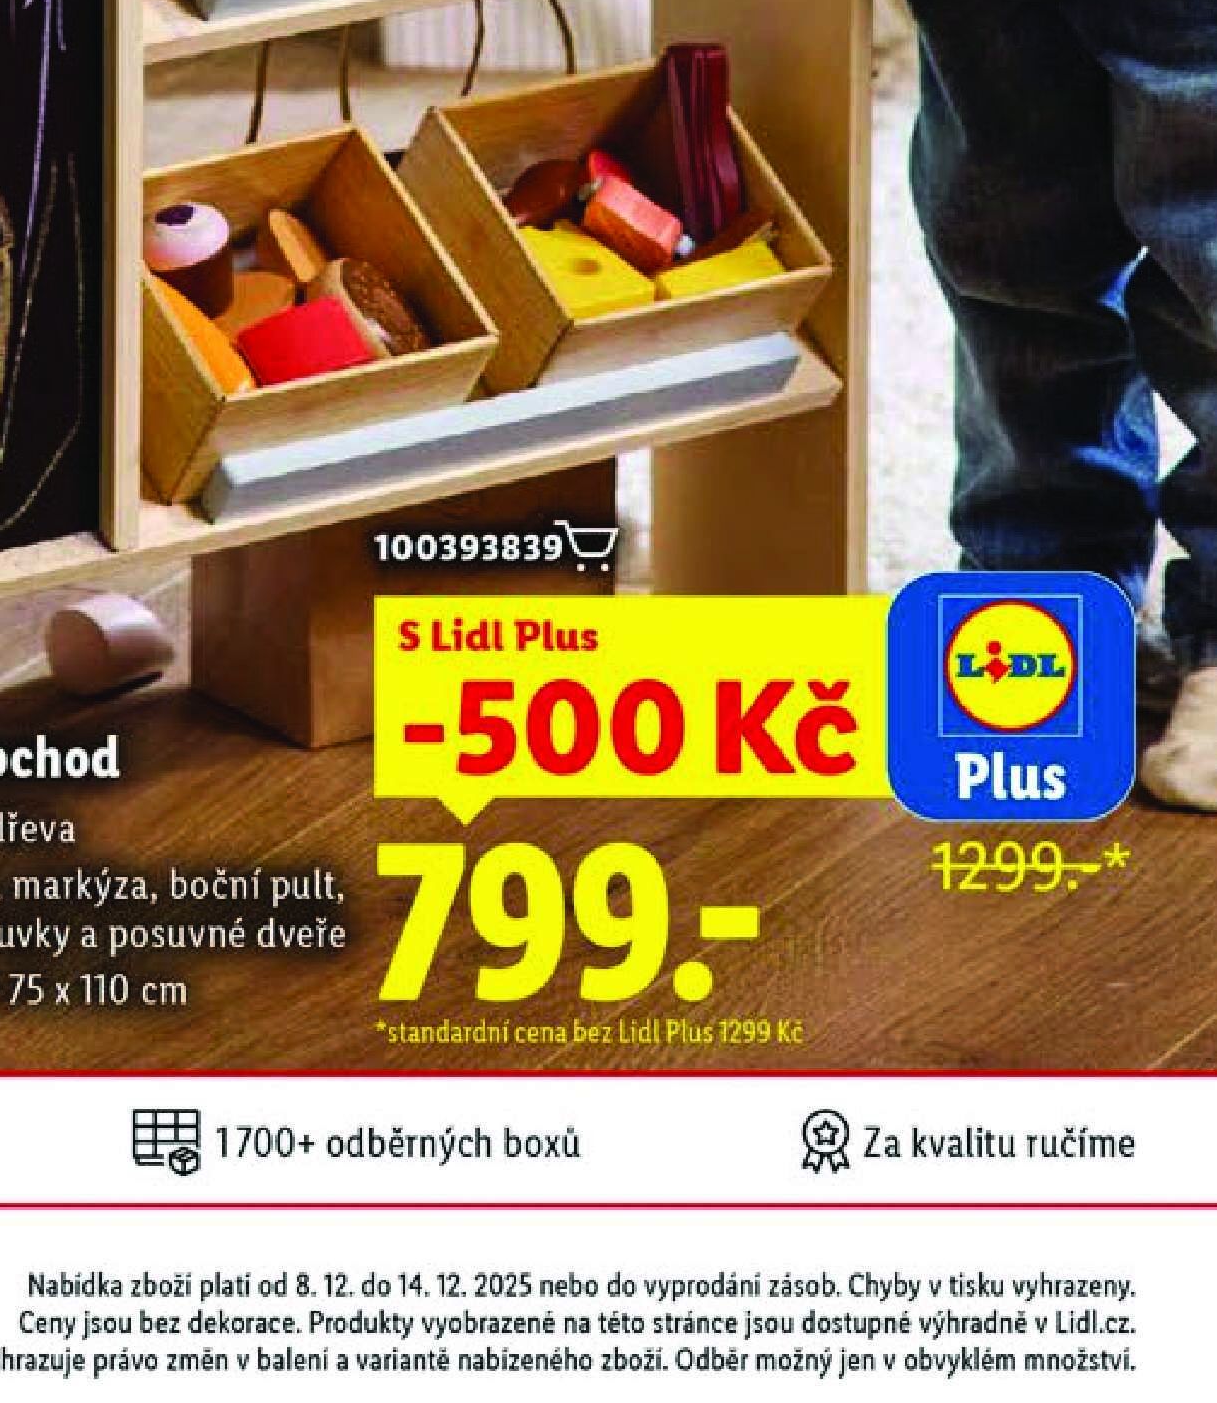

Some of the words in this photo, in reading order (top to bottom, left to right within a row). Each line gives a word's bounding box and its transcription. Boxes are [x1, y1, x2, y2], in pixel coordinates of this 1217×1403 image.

[373, 534, 563, 562] 100393839
[400, 621, 421, 652] S
[431, 618, 504, 652] Lidl
[513, 619, 599, 652] Plus
[956, 640, 1066, 683] LIDL
[404, 678, 686, 777] -500
[715, 680, 857, 777] Kč
[955, 751, 1065, 800] Plus
[13, 869, 158, 907] markýza,
[171, 869, 262, 900] boční
[272, 869, 344, 907] pult,
[81, 927, 98, 948] a
[110, 917, 245, 957] posuvné
[257, 917, 346, 948] dveře
[9, 973, 42, 1003] 75
[55, 982, 69, 1003] x
[81, 973, 129, 1003] 110
[142, 982, 187, 1003] cm
[513, 1026, 568, 1047] cena
[571, 1018, 614, 1046] bez
[619, 1017, 661, 1045] Lidl
[665, 1017, 715, 1045] Plus
[718, 1017, 773, 1044] 1299
[776, 1018, 804, 1044] Kč
[216, 1127, 315, 1158] 1700+
[327, 1127, 491, 1167] odběrných
[503, 1127, 580, 1158] boxů
[863, 1127, 901, 1158] Za
[913, 1127, 1016, 1158] kvalitu
[1026, 1127, 1135, 1158] ručíme
[28, 1271, 122, 1298] Nabídka
[130, 1271, 192, 1298] zboží
[200, 1271, 250, 1302] platí
[257, 1271, 288, 1298] od
[296, 1271, 317, 1298] 8.
[323, 1271, 353, 1298] 12.
[361, 1271, 392, 1298] do
[398, 1272, 429, 1298] 14.
[436, 1271, 467, 1298] 12.
[474, 1271, 532, 1298] 2025
[539, 1271, 599, 1298] nebo
[607, 1271, 638, 1298] do
[643, 1271, 761, 1302] vyprodání
[769, 1271, 840, 1298] zásob.
[848, 1271, 921, 1302] Chyby
[928, 1279, 942, 1298] v
[949, 1271, 1004, 1298] tisku
[1012, 1271, 1136, 1302] vyhrazeny.
[19, 1310, 76, 1341] Ceny
[81, 1310, 132, 1341] jsou
[139, 1310, 182, 1334] bez
[187, 1308, 303, 1334] dekorace.
[310, 1308, 414, 1340] Produkty
[421, 1309, 556, 1341] vyobrazené
[564, 1315, 592, 1334] na
[597, 1310, 645, 1334] této
[653, 1310, 739, 1334] stránce
[744, 1310, 795, 1341] jsou
[802, 1310, 912, 1341] dostupné
[918, 1308, 1028, 1341] výhradně
[1034, 1317, 1048, 1334] v
[1055, 1308, 1137, 1334] Lidl.cz.
[93, 1347, 158, 1380] právo
[166, 1349, 228, 1372] změn
[236, 1353, 250, 1370] v
[257, 1346, 329, 1372] balení
[336, 1353, 349, 1372] a
[356, 1346, 450, 1372] variantě
[458, 1346, 592, 1372] nabízeného
[600, 1346, 669, 1372] zboží.
[674, 1346, 749, 1372] Odběr
[756, 1347, 833, 1380] možný
[838, 1347, 874, 1380] jen
[882, 1353, 896, 1371] v
[904, 1346, 1016, 1380] obvyklém
[1024, 1346, 1137, 1372] množství.
